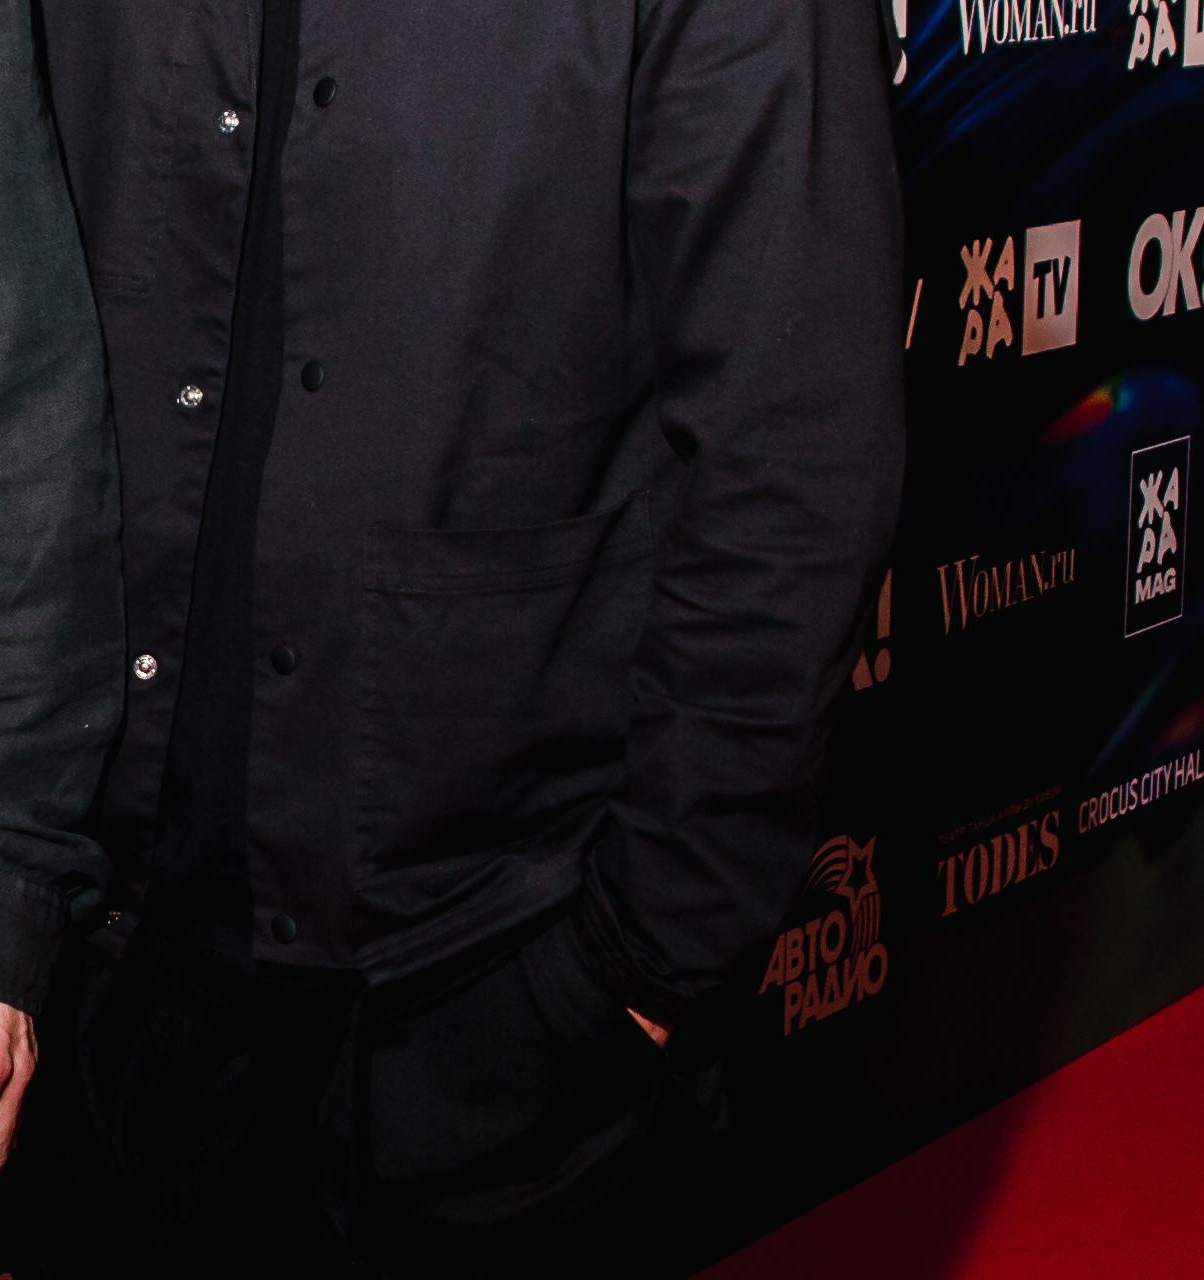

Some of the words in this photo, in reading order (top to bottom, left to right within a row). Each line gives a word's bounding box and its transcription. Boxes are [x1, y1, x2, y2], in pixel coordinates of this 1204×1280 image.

[1033, 255, 1072, 320] TV
[1128, 206, 1204, 321] OK
[1135, 567, 1177, 605] MAG
[1079, 777, 1138, 834] CROCUS
[1140, 762, 1173, 805] CITY
[937, 809, 1062, 919] TODES
[758, 909, 846, 995] АВТО
[784, 943, 889, 1036] РАДИО
